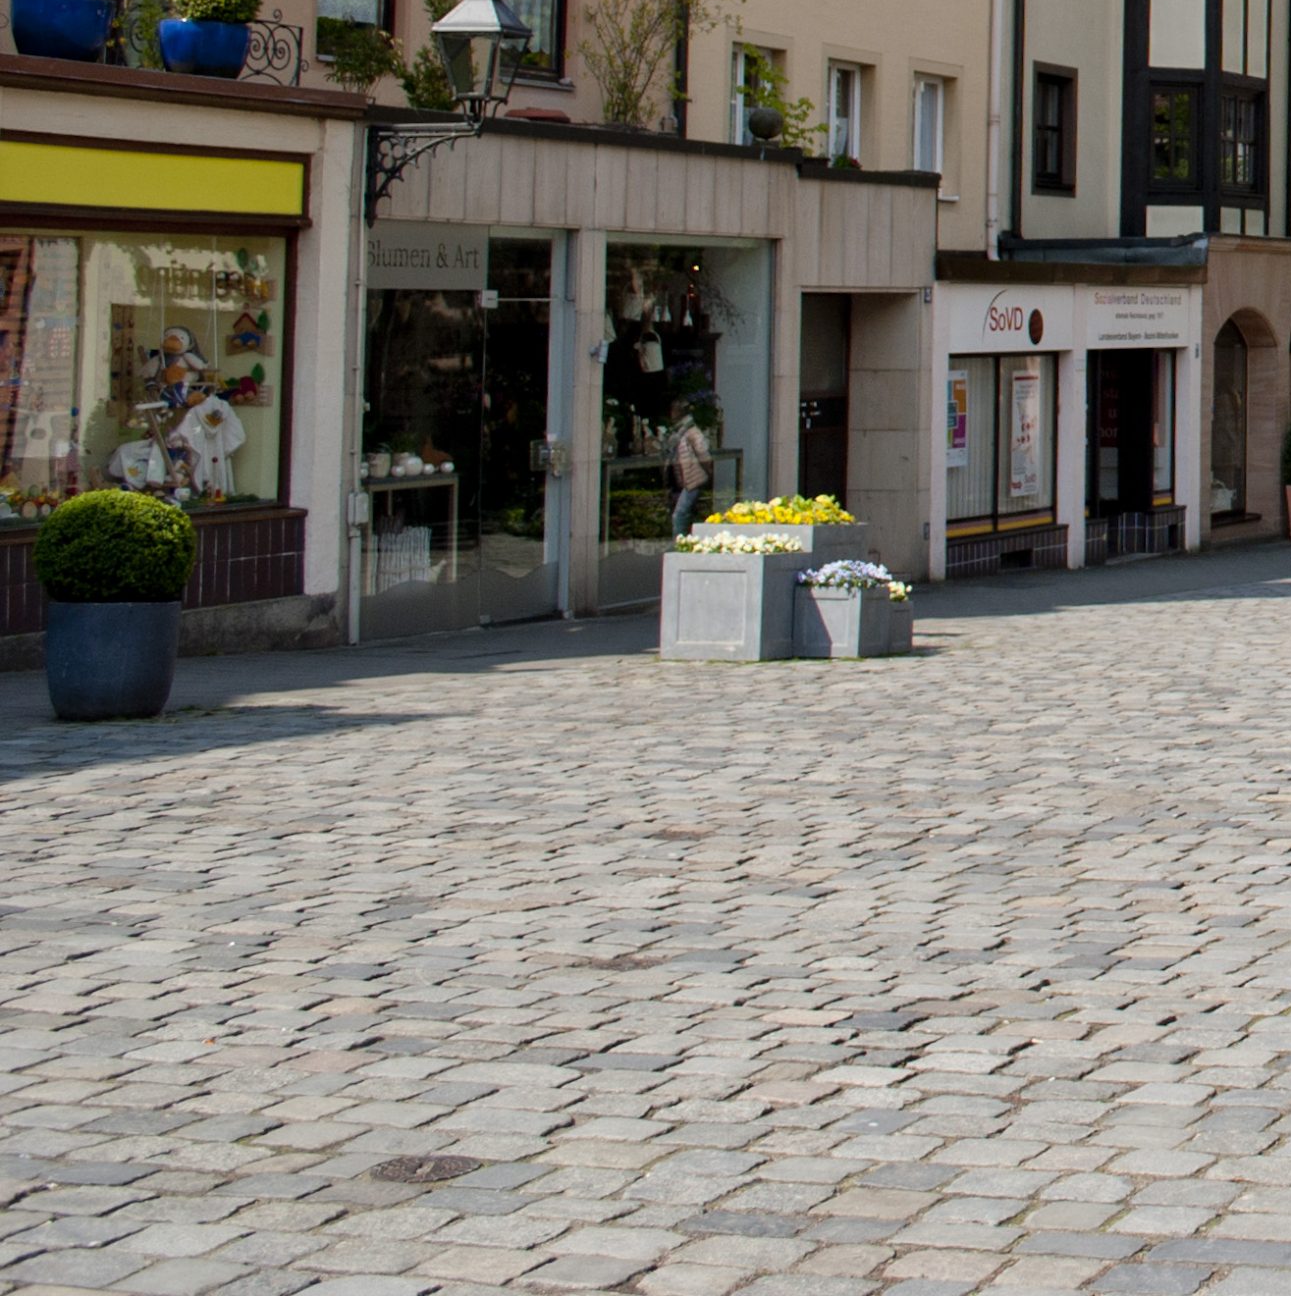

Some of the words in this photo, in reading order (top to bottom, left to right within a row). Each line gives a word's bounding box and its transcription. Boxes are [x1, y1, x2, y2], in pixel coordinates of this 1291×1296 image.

[436, 242, 449, 269] &
[452, 244, 480, 270] Art
[1140, 292, 1182, 306] Deutschland
[989, 306, 1024, 332] SoVD
